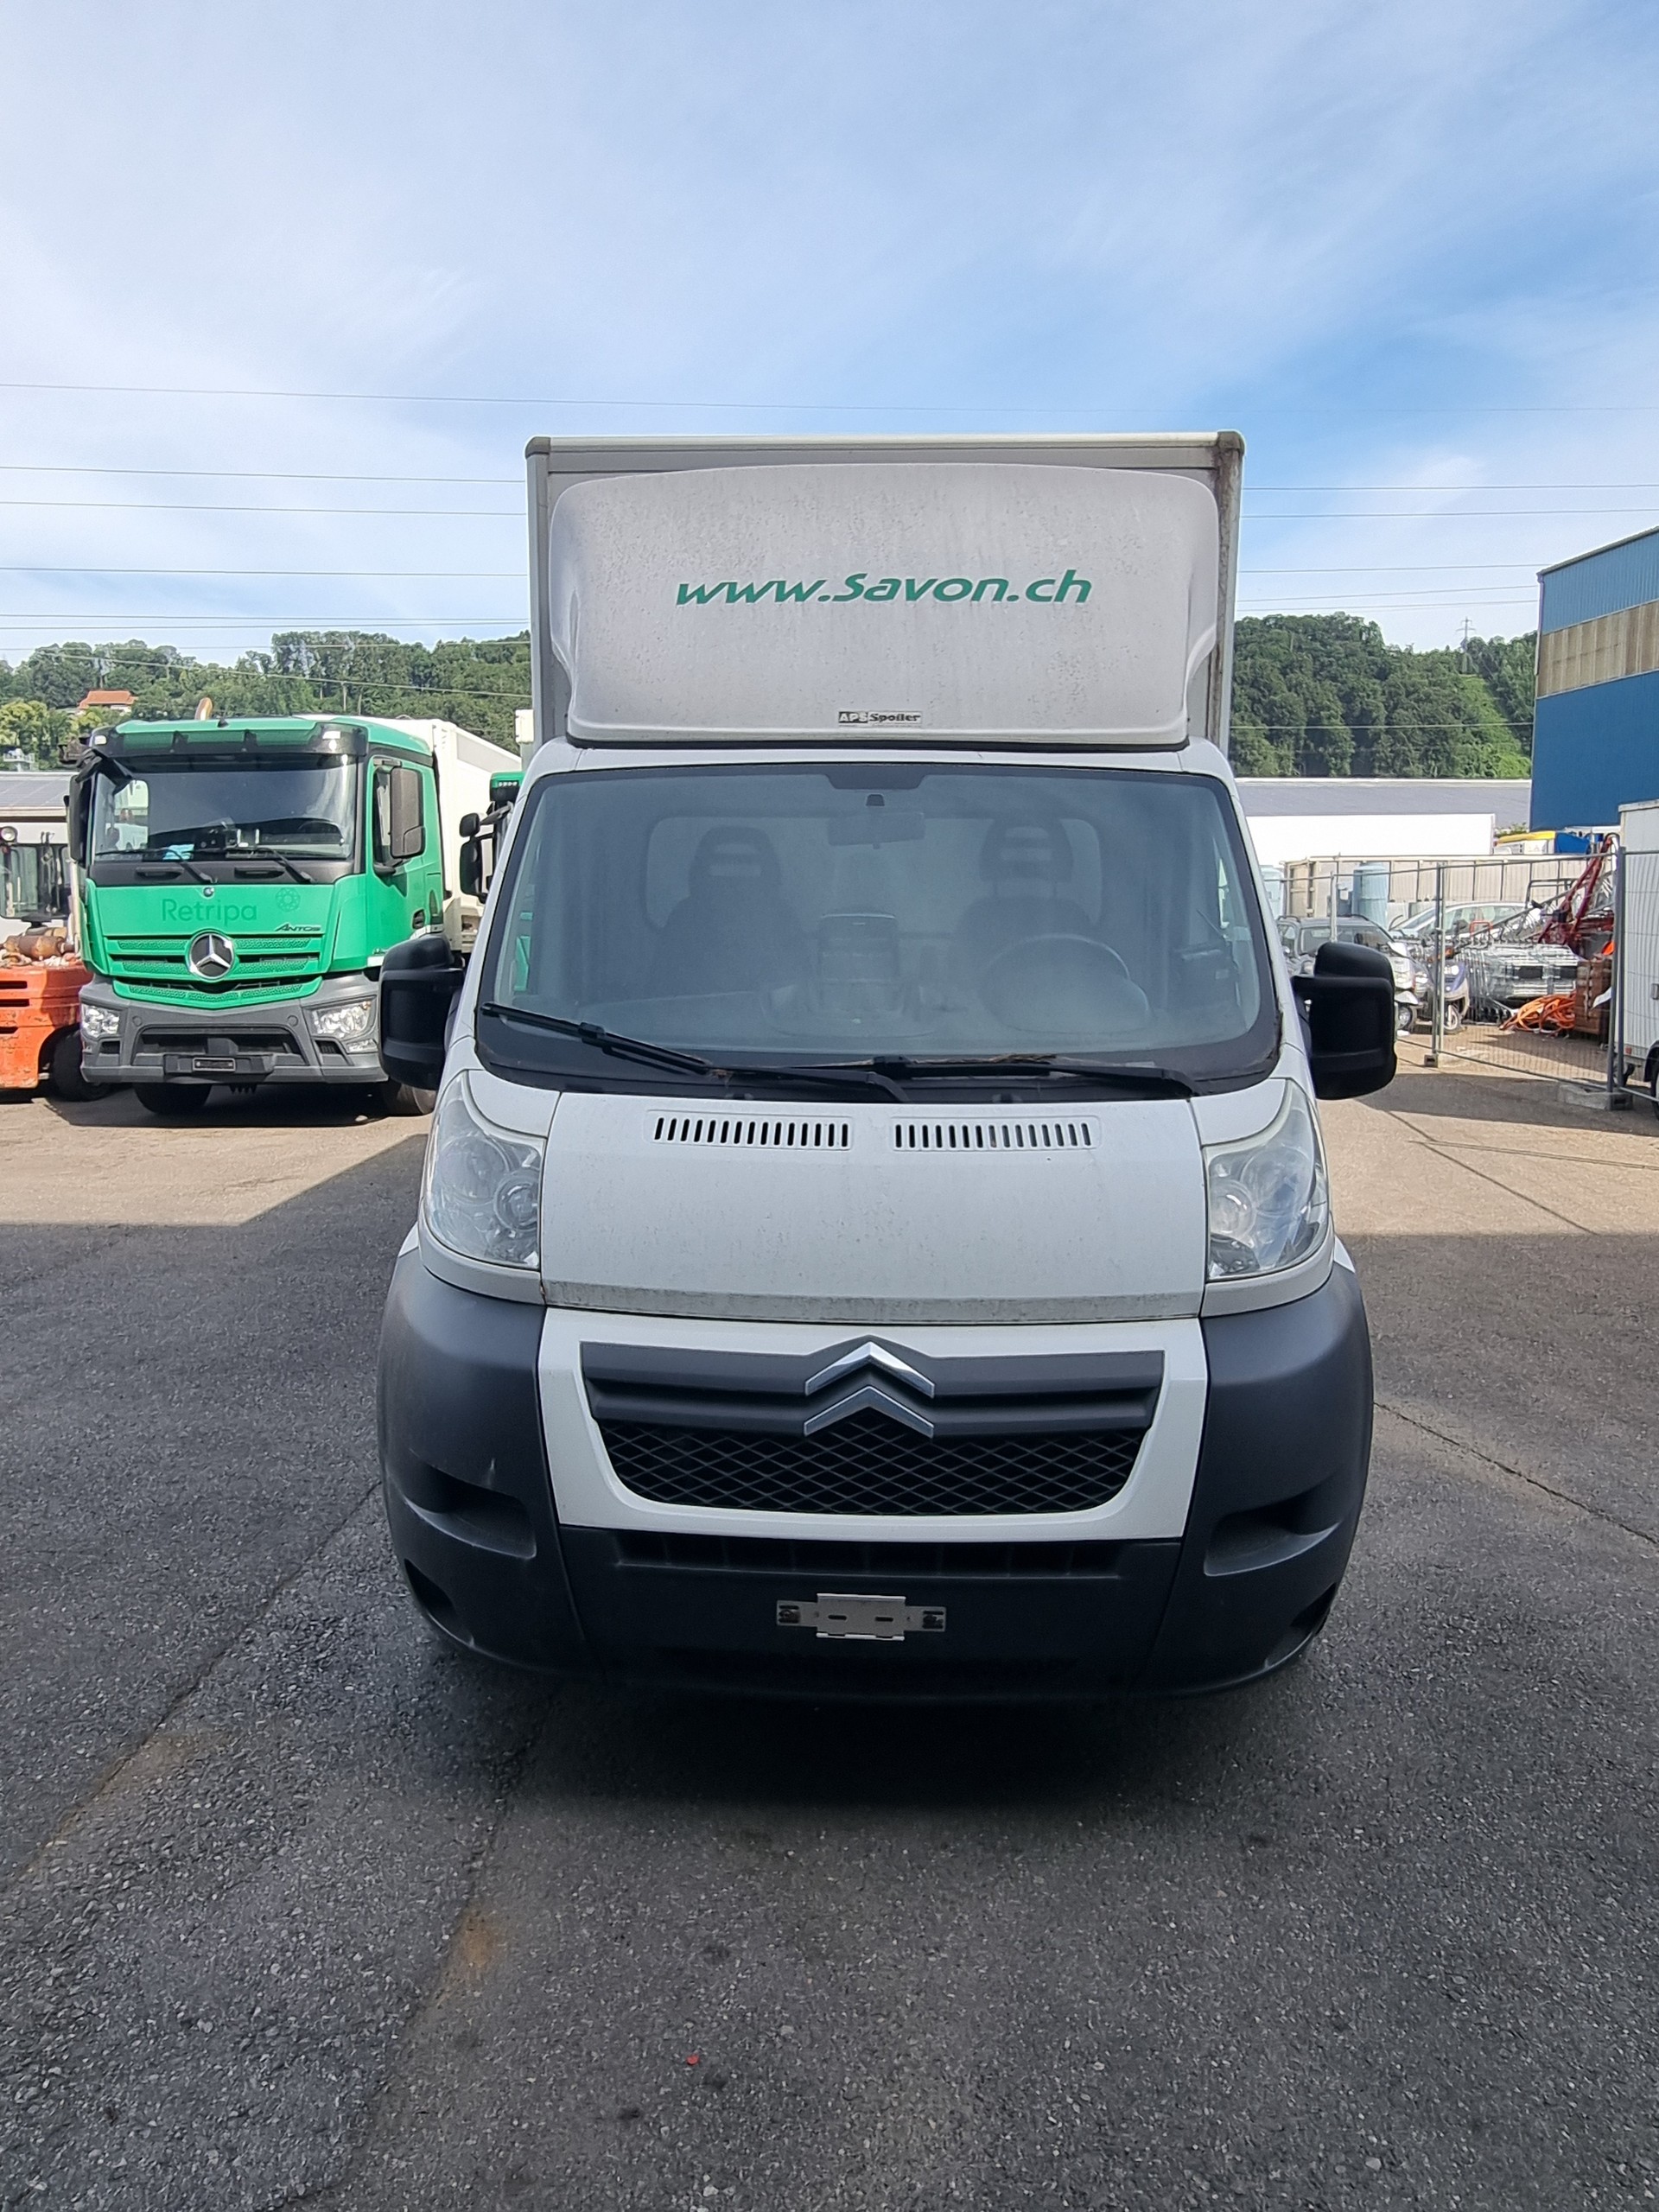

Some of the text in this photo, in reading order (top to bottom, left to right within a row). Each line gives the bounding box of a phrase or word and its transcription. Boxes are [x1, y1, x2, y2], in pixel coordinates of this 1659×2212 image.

[677, 569, 1092, 605] www.Savon.ch
[839, 712, 921, 723] APS Spoiler
[162, 898, 258, 926] Retripa
